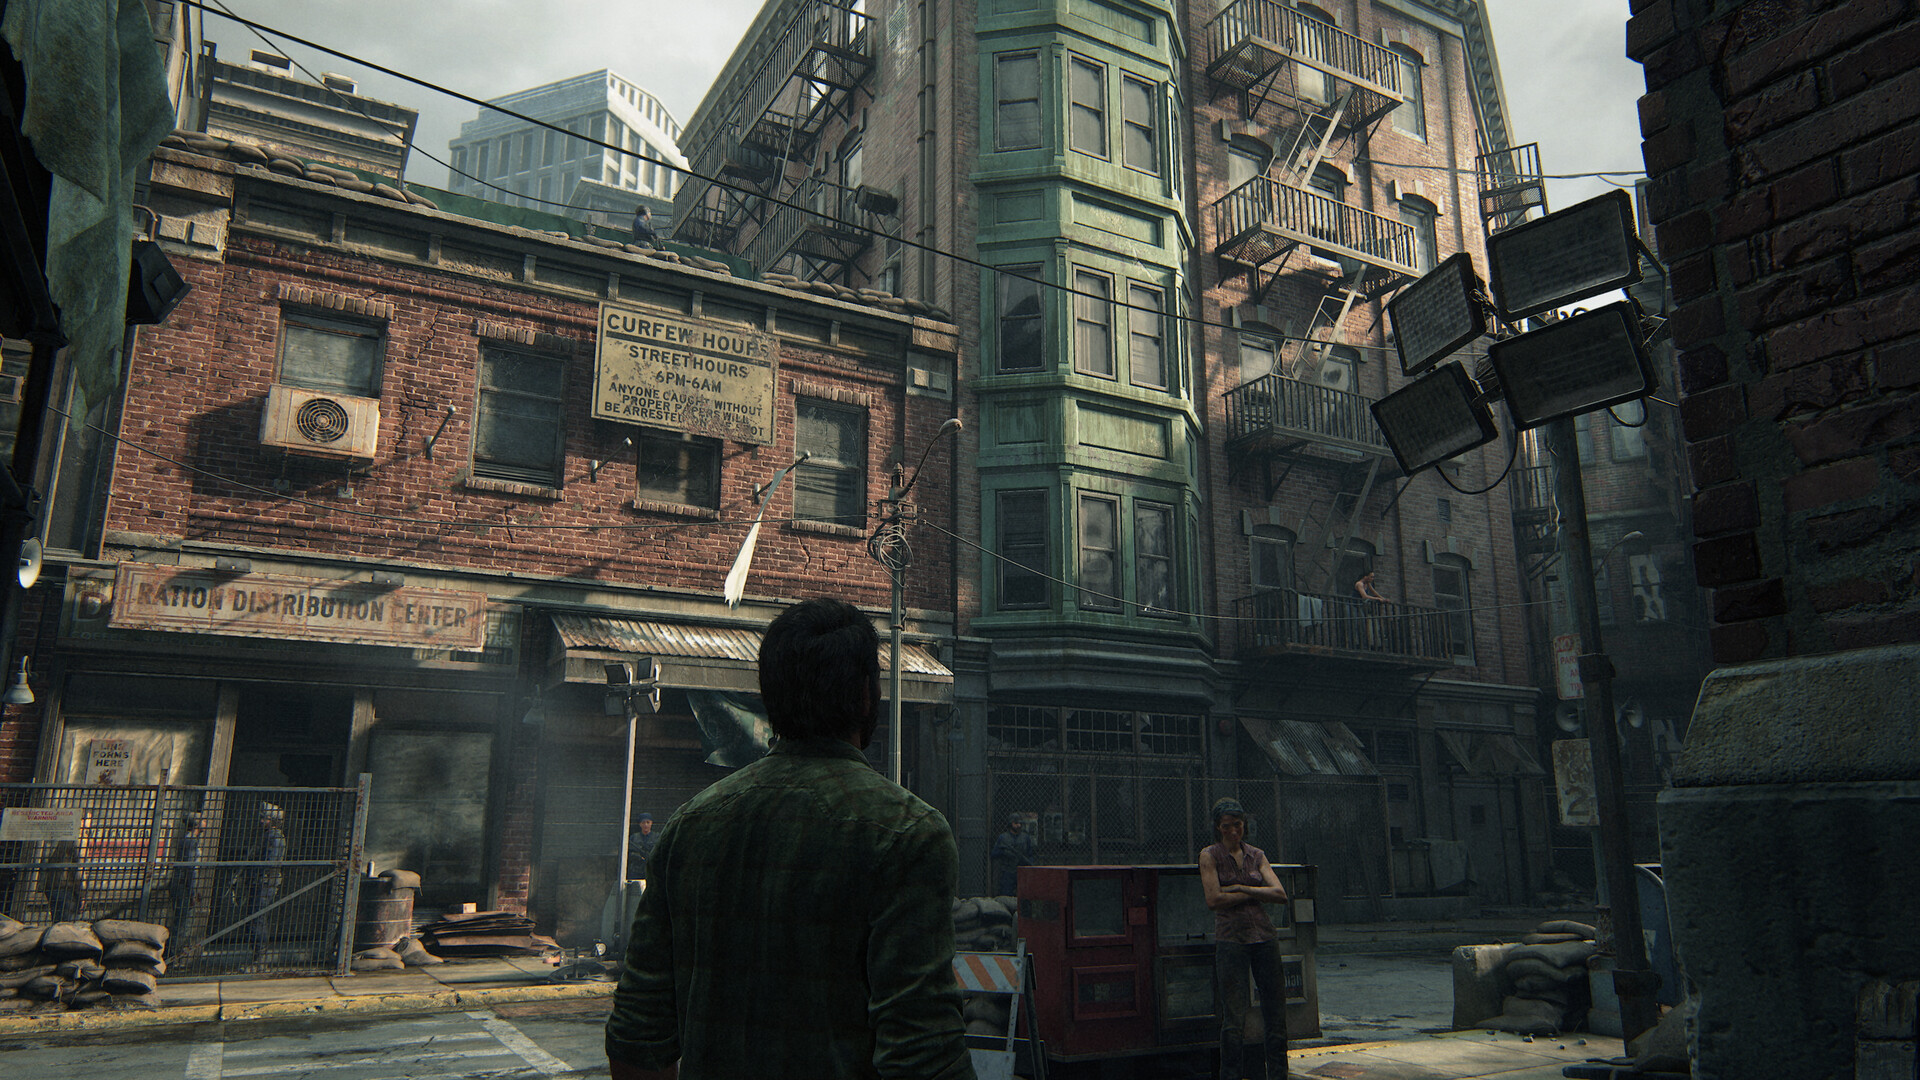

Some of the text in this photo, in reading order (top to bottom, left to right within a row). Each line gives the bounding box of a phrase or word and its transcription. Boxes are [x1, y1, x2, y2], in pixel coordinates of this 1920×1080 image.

[607, 313, 770, 359] CURFEW HOURS
[629, 345, 749, 379] STREET HOURS
[656, 370, 722, 394] 6PM-6AM
[604, 401, 621, 414] BE
[608, 381, 660, 400] ANYONE
[714, 400, 763, 417] WITHOUT
[622, 394, 671, 412] PROPER
[723, 411, 749, 425] WILL
[136, 582, 468, 628] RATION DISTRIBUTION CENTER
[93, 751, 130, 759] FORMS
[95, 759, 125, 768] HERE
